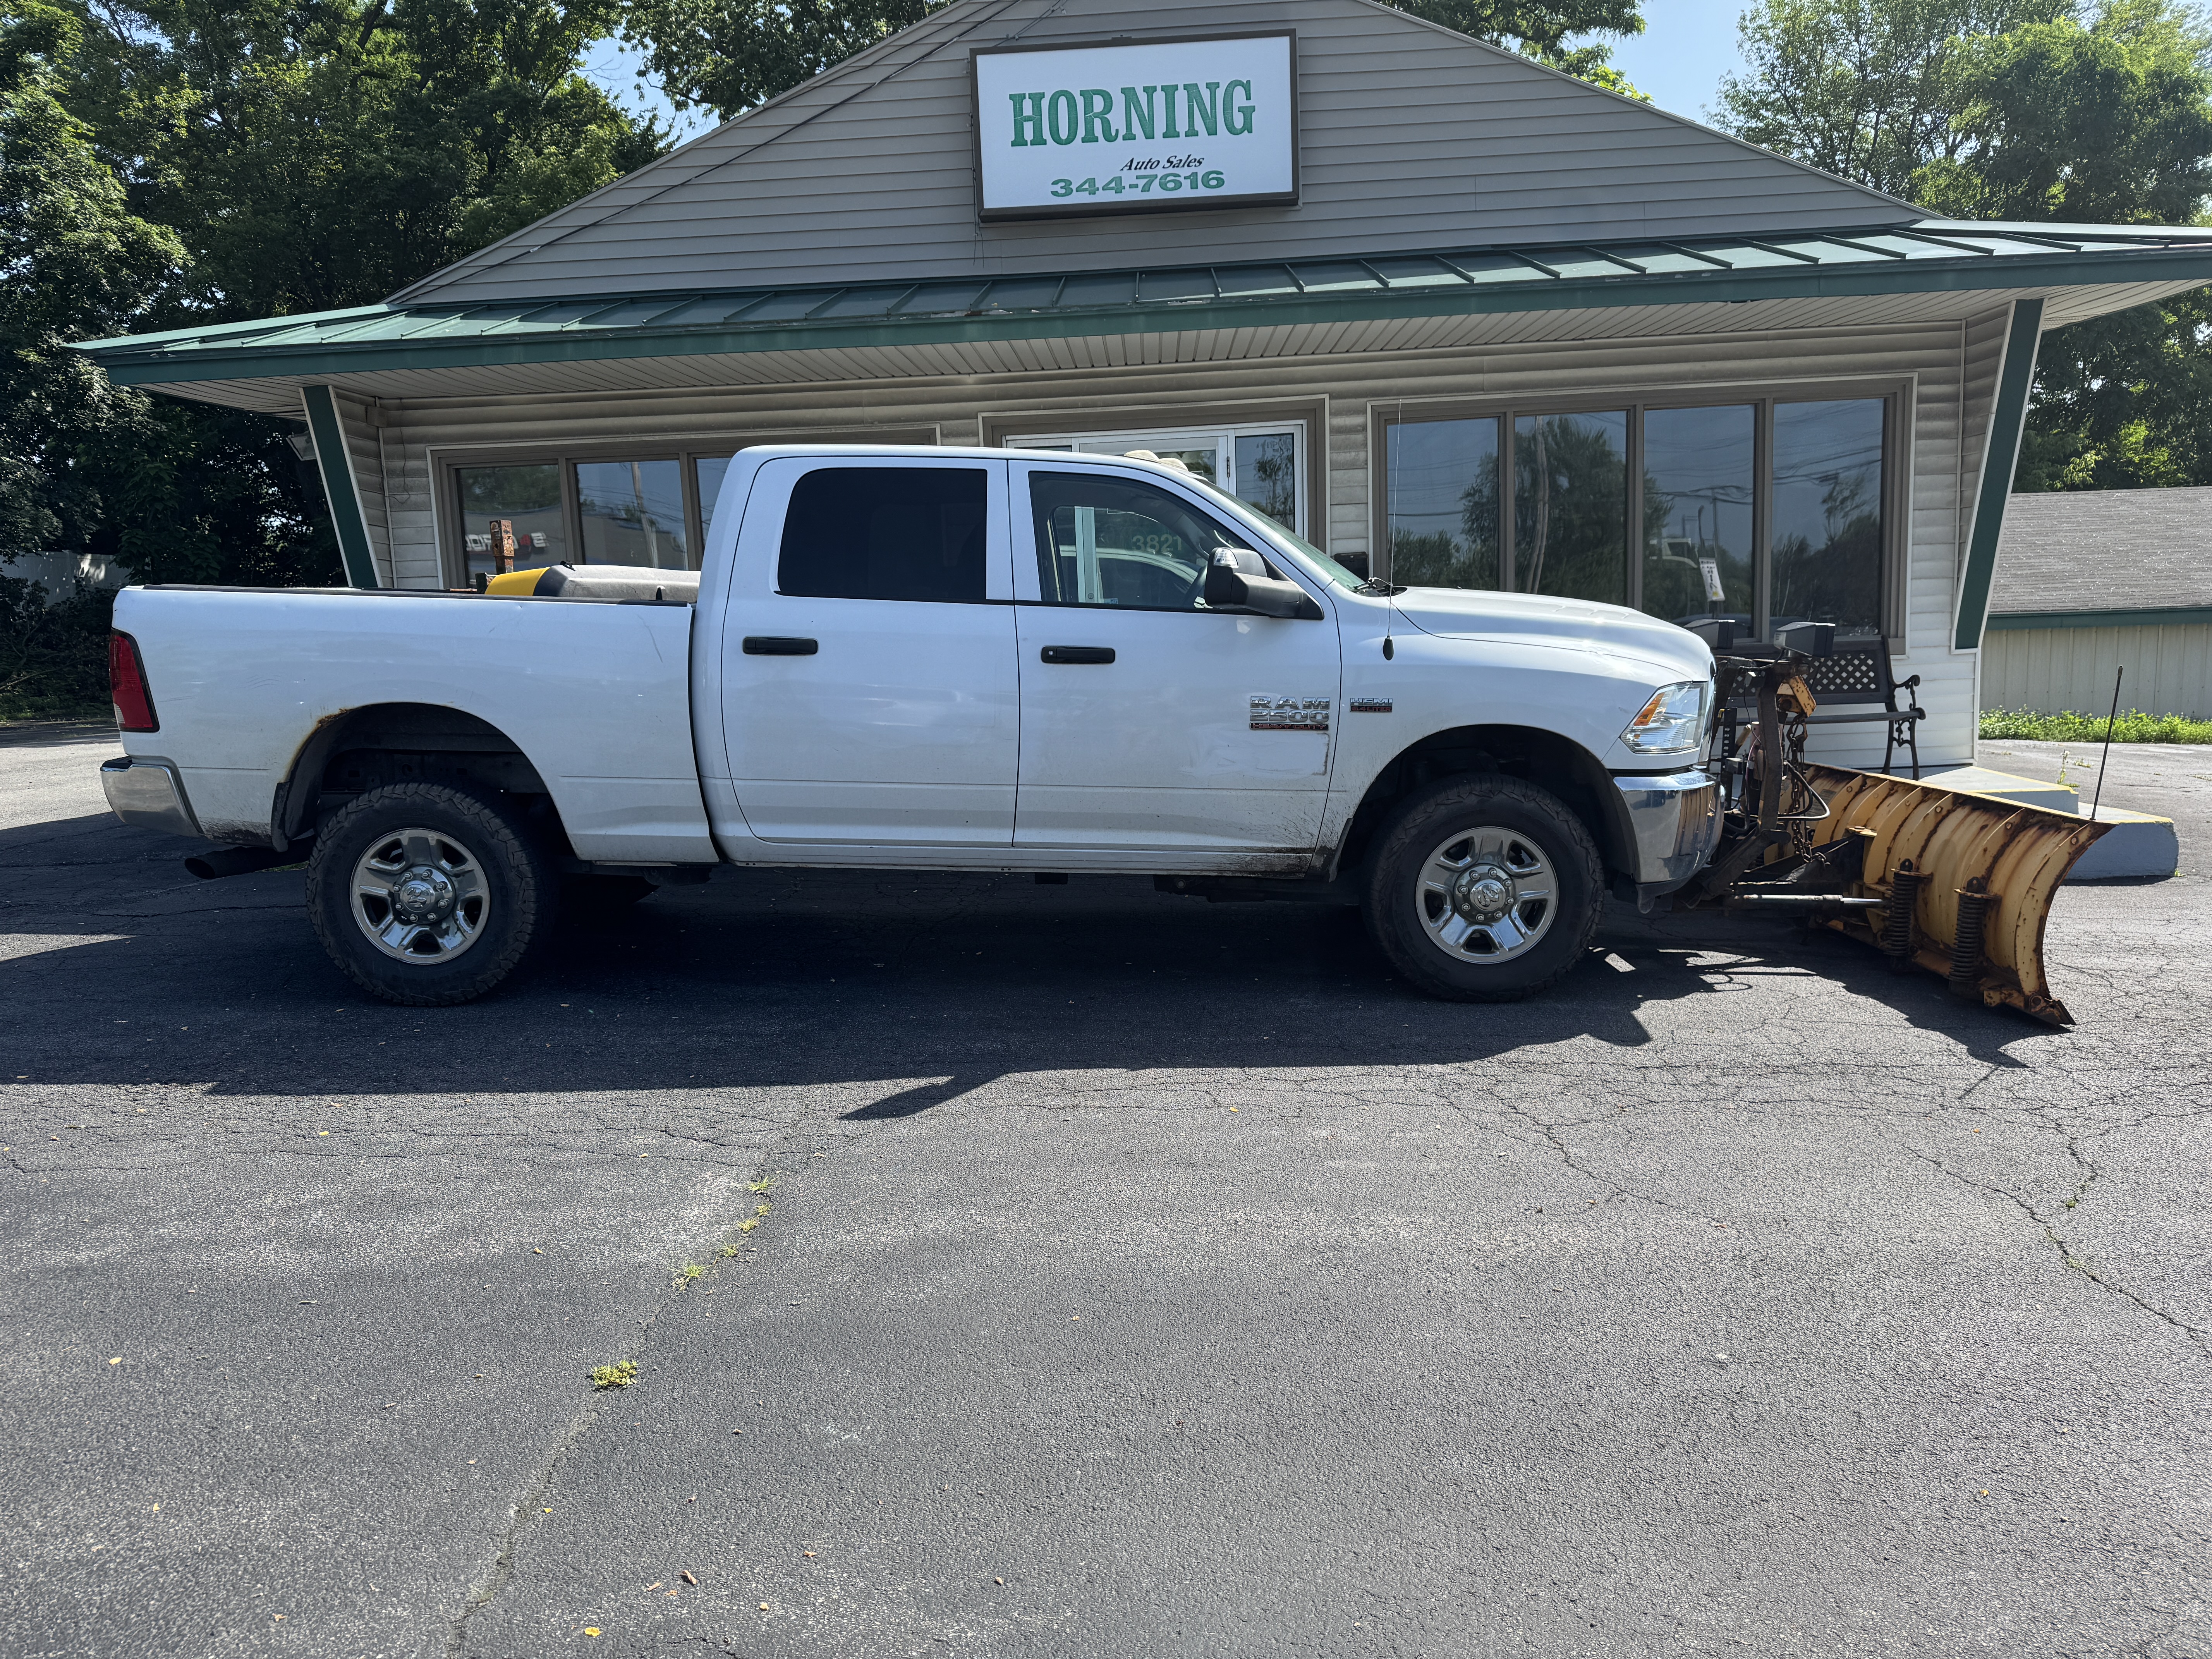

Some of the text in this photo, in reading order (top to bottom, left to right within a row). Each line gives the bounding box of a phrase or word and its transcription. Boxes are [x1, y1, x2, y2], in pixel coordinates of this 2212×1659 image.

[1009, 79, 1255, 147] HORNING
[1120, 154, 1205, 171] Auto Sales
[1051, 170, 1225, 197] 344-7616
[1132, 534, 1182, 551] 3821
[1250, 696, 1330, 709] RAM
[1250, 709, 1329, 722] 2500
